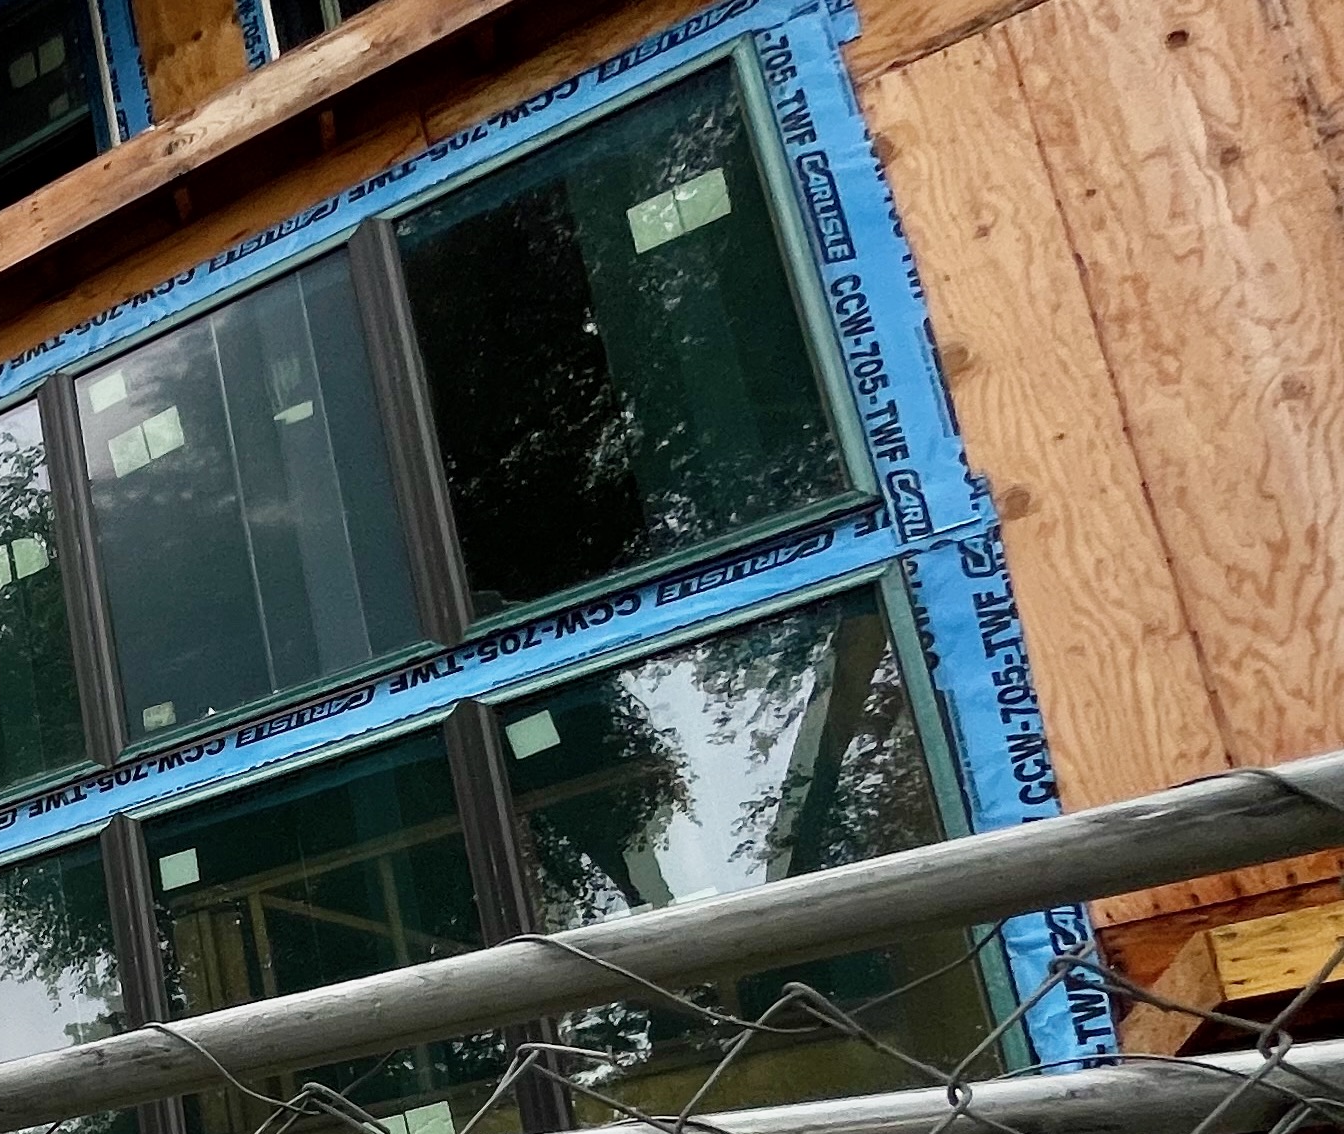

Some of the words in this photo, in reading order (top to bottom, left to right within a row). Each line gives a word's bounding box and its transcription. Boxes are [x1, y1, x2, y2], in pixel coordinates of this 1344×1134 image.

[797, 150, 858, 265] CARLISLE
[829, 275, 910, 462] CCW-705-TWF
[390, 593, 642, 698] CCW-705-TWF
[973, 591, 1062, 808] CCW-705-TWF
[28, 740, 225, 820] CCW-705-TWF
